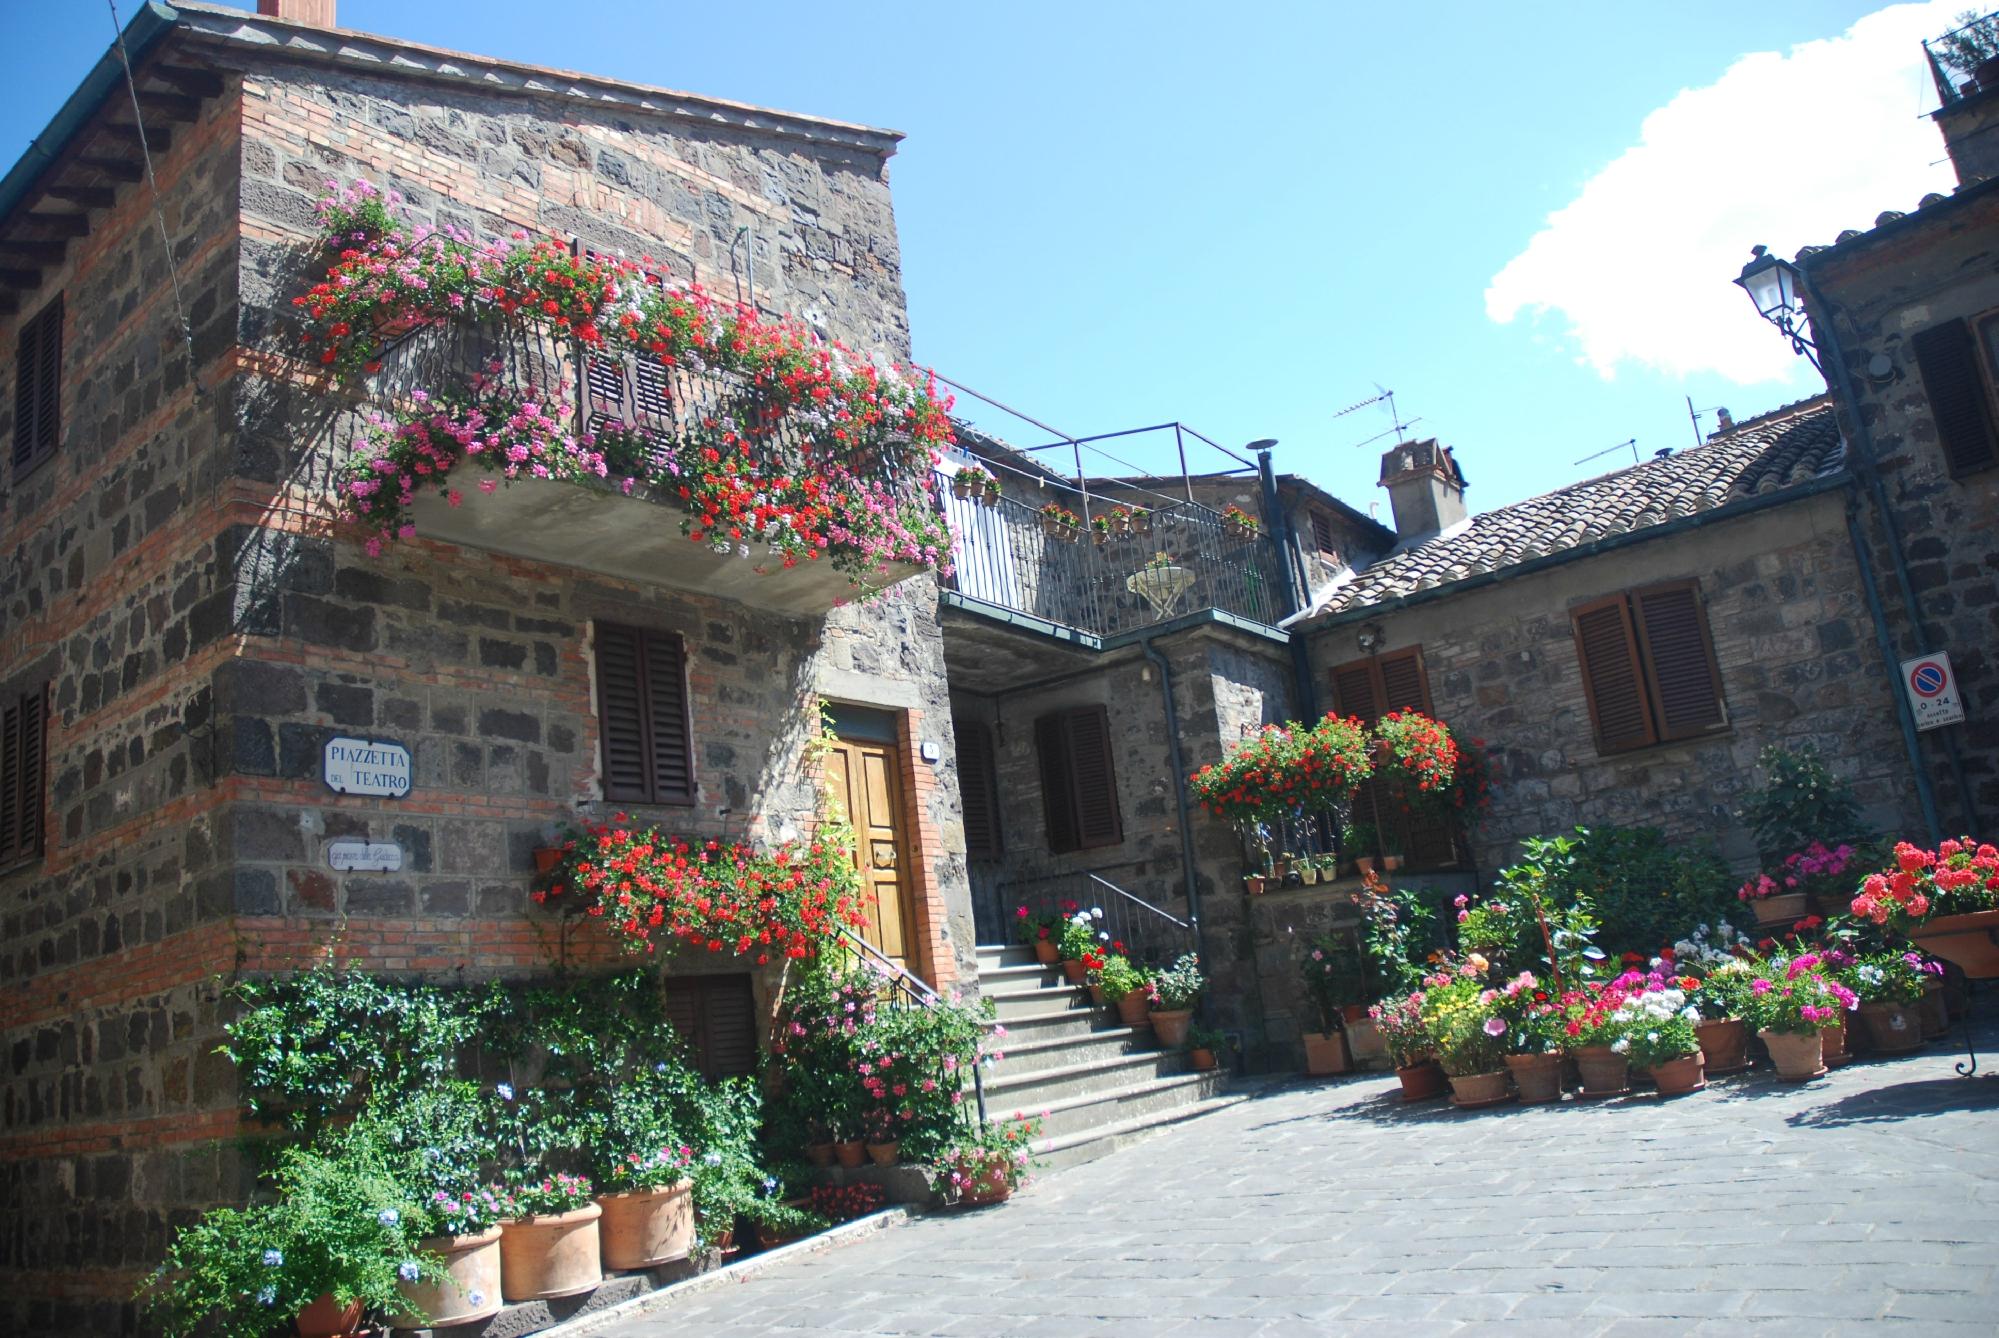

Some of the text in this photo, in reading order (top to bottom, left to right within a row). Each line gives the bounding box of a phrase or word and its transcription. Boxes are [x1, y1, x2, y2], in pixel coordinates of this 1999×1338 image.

[1920, 702, 1927, 710] 0
[1936, 697, 1950, 706] 24
[331, 746, 405, 767] PIAZZETTA
[330, 771, 407, 789] DEL TEATRO
